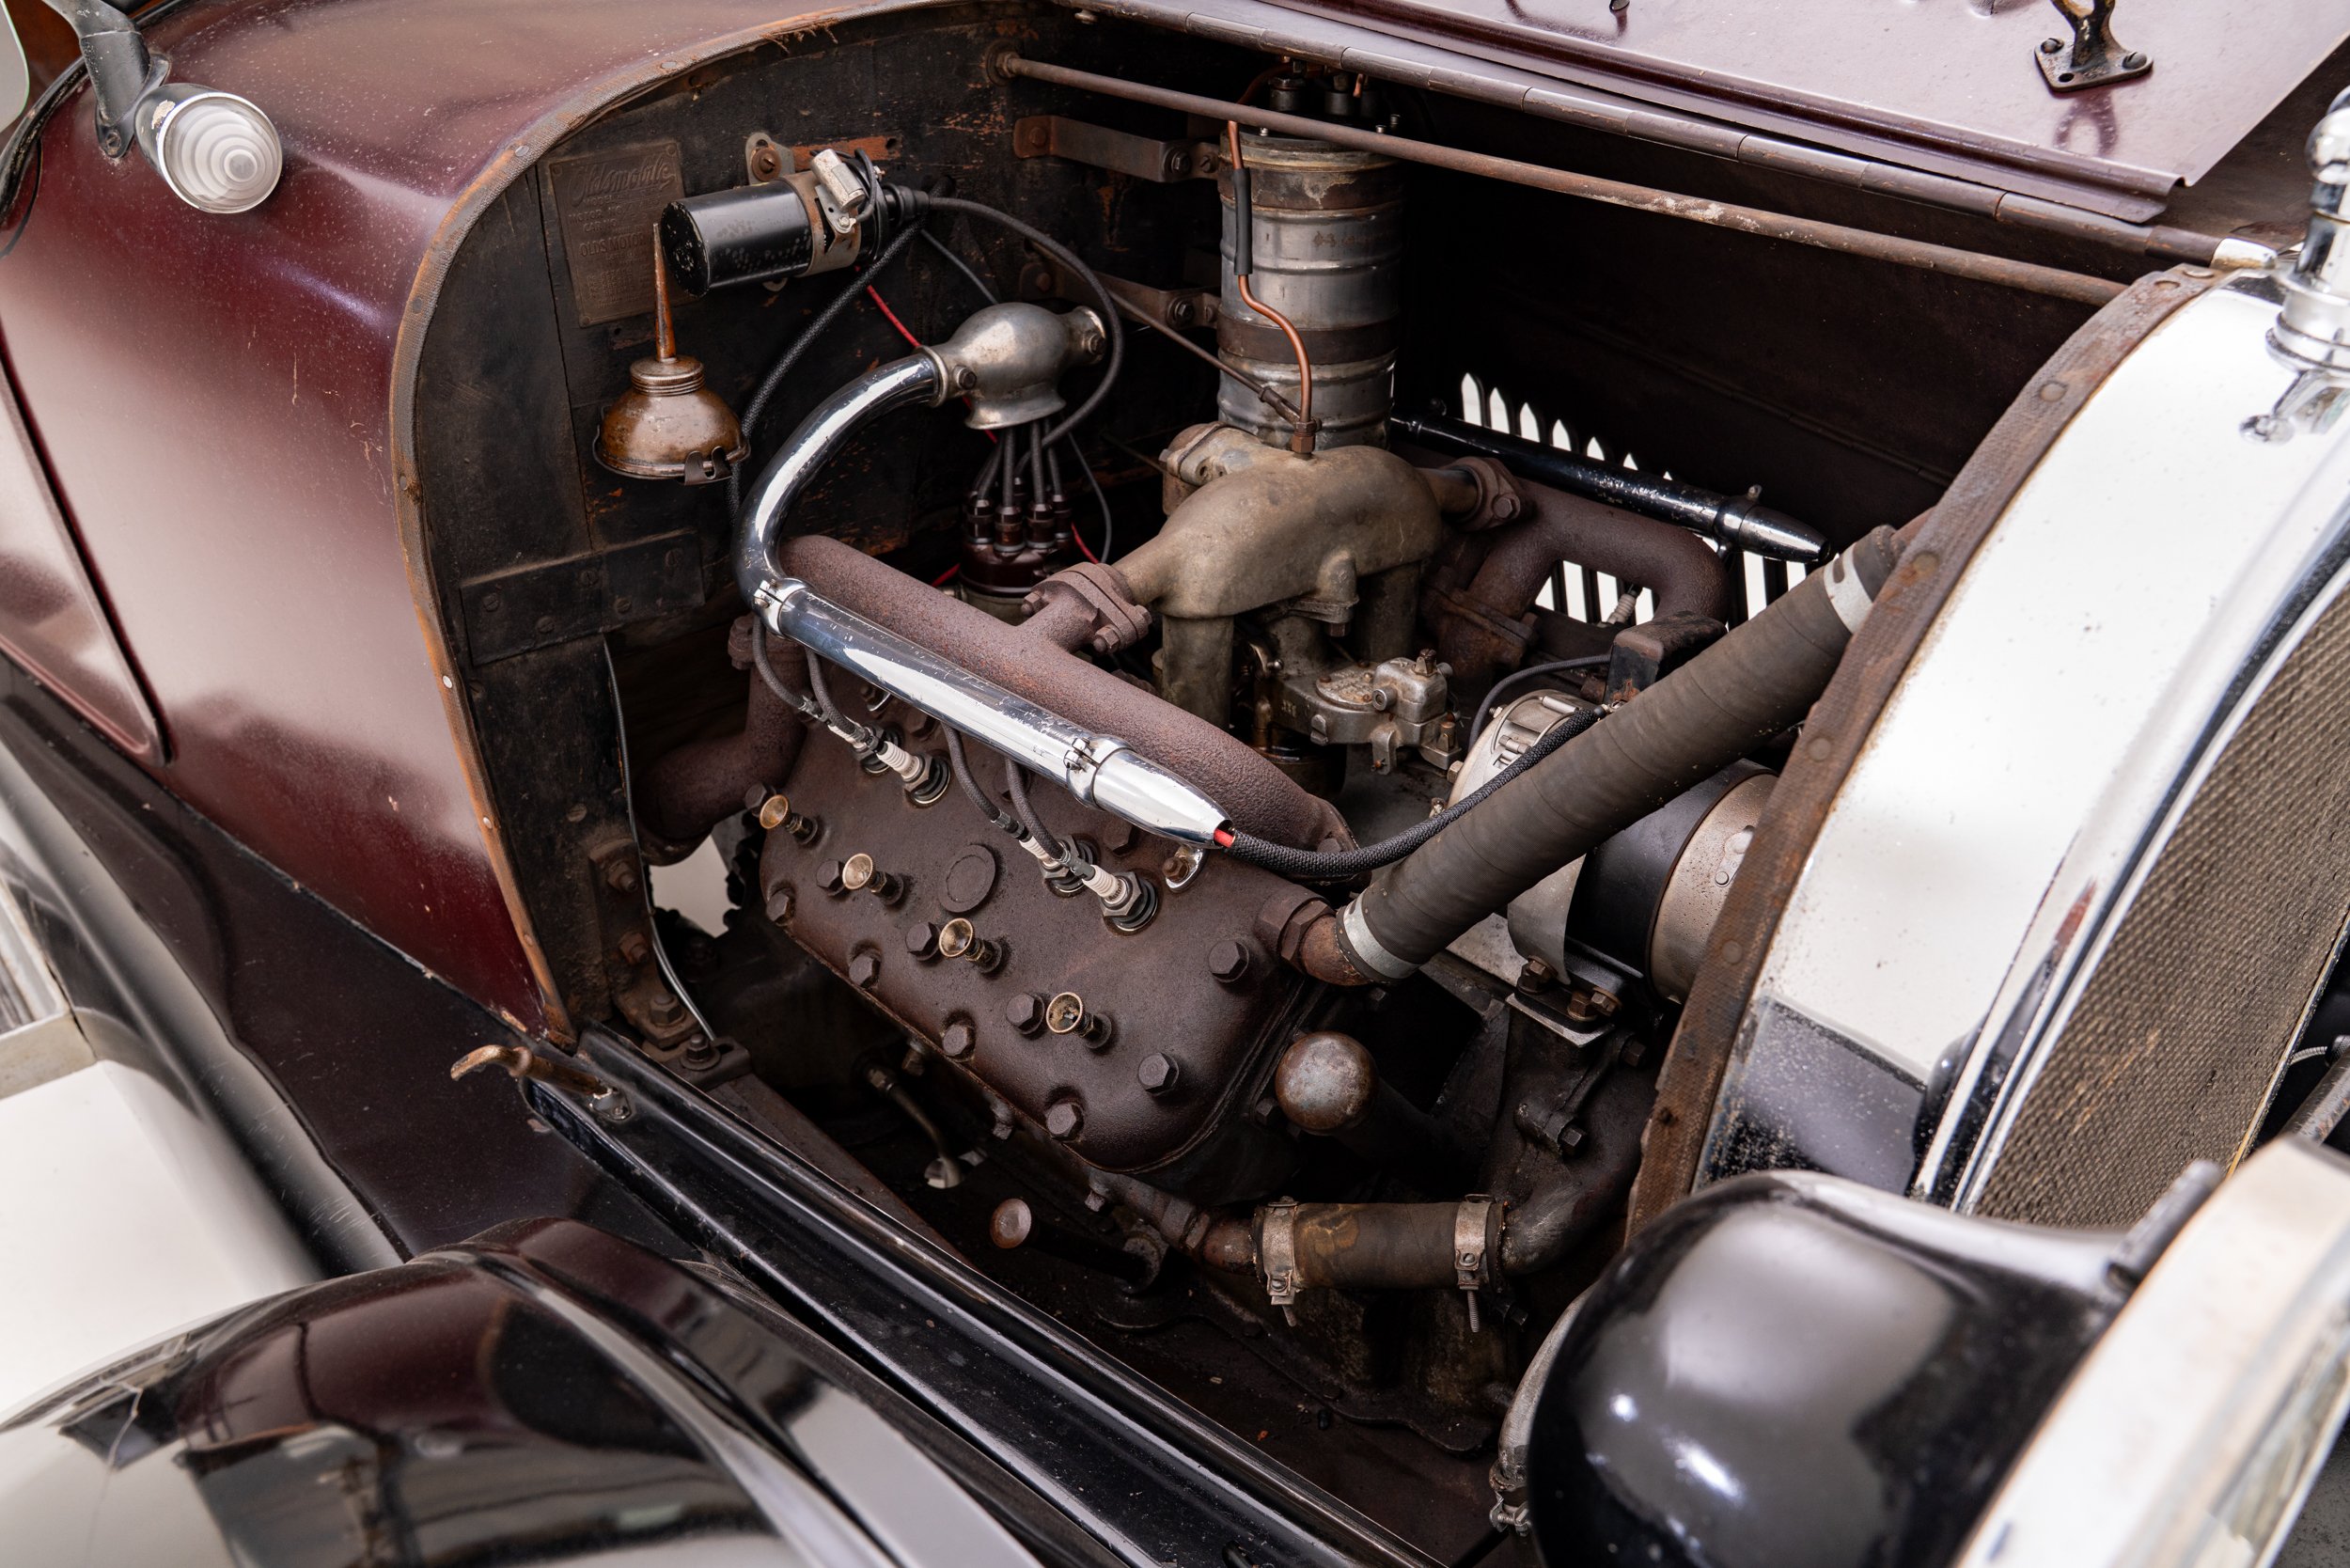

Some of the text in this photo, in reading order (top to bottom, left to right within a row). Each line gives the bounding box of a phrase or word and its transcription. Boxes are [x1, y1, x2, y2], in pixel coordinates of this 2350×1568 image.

[568, 154, 677, 207] Oldsmobile
[583, 195, 614, 207] MODEL
[569, 209, 603, 225] MOTOR
[583, 221, 603, 233] CAR
[579, 239, 608, 257] OLDS
[608, 232, 646, 253] MOTOR
